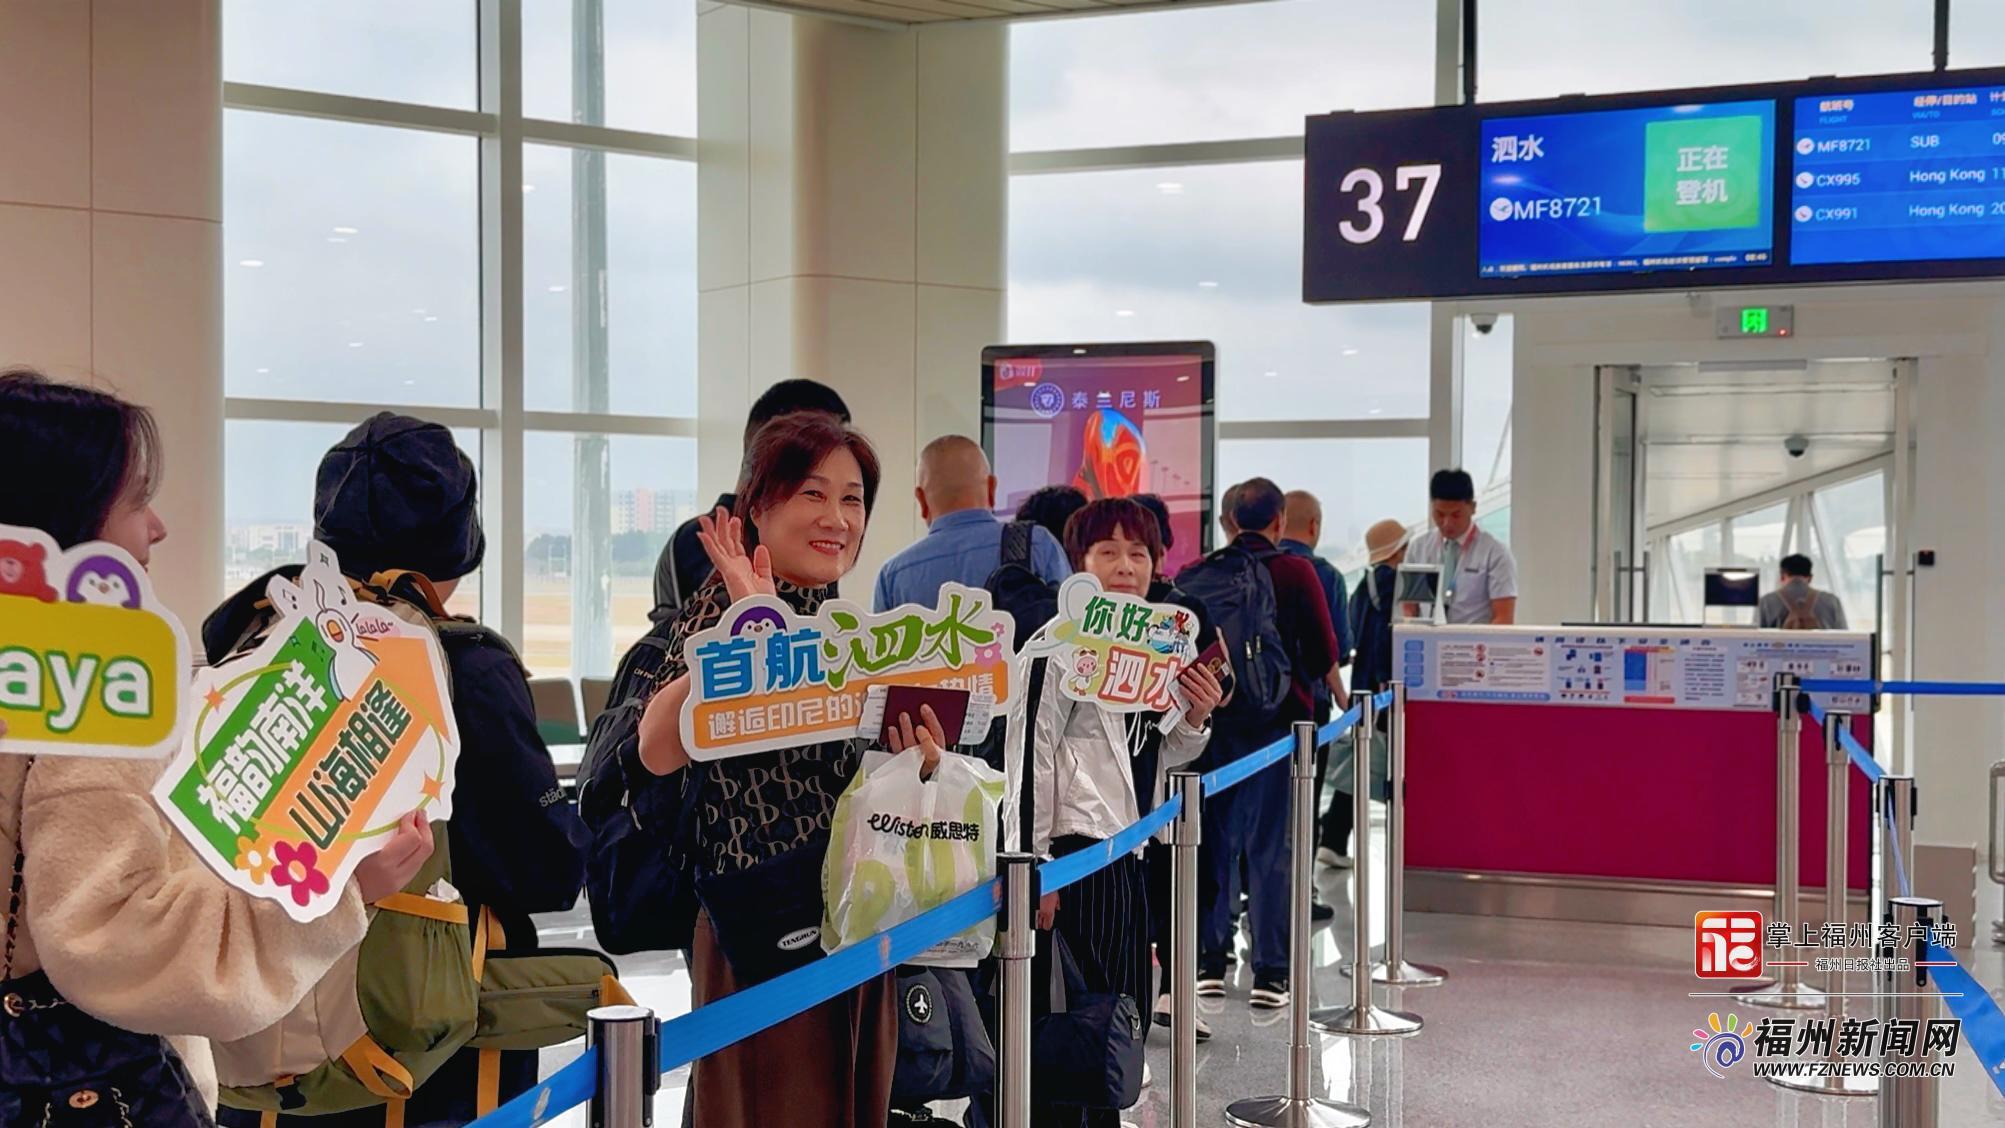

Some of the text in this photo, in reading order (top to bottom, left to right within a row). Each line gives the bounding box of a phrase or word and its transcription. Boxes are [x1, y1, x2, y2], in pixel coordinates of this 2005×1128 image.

[1491, 136, 1544, 162] 泗水
[1817, 139, 1871, 153] MF8721
[1909, 135, 1940, 148] SUB
[1676, 146, 1728, 173] 正在
[1816, 173, 1861, 187] CX995
[1909, 170, 1946, 185] Hong
[1949, 169, 1986, 183] Kong
[1338, 164, 1442, 244] 37
[1676, 179, 1728, 206] 登机
[1513, 196, 1602, 221] MF8721
[1815, 208, 1858, 222] CX991
[1908, 205, 1945, 218] Hong
[1948, 204, 1985, 217] Kong
[1071, 390, 1161, 409] 泰兰尼斯
[1082, 596, 1153, 642] 你好
[696, 595, 994, 699] 首航泗水
[288, 680, 412, 850] 山海相逢
[930, 821, 980, 841] 威思特
